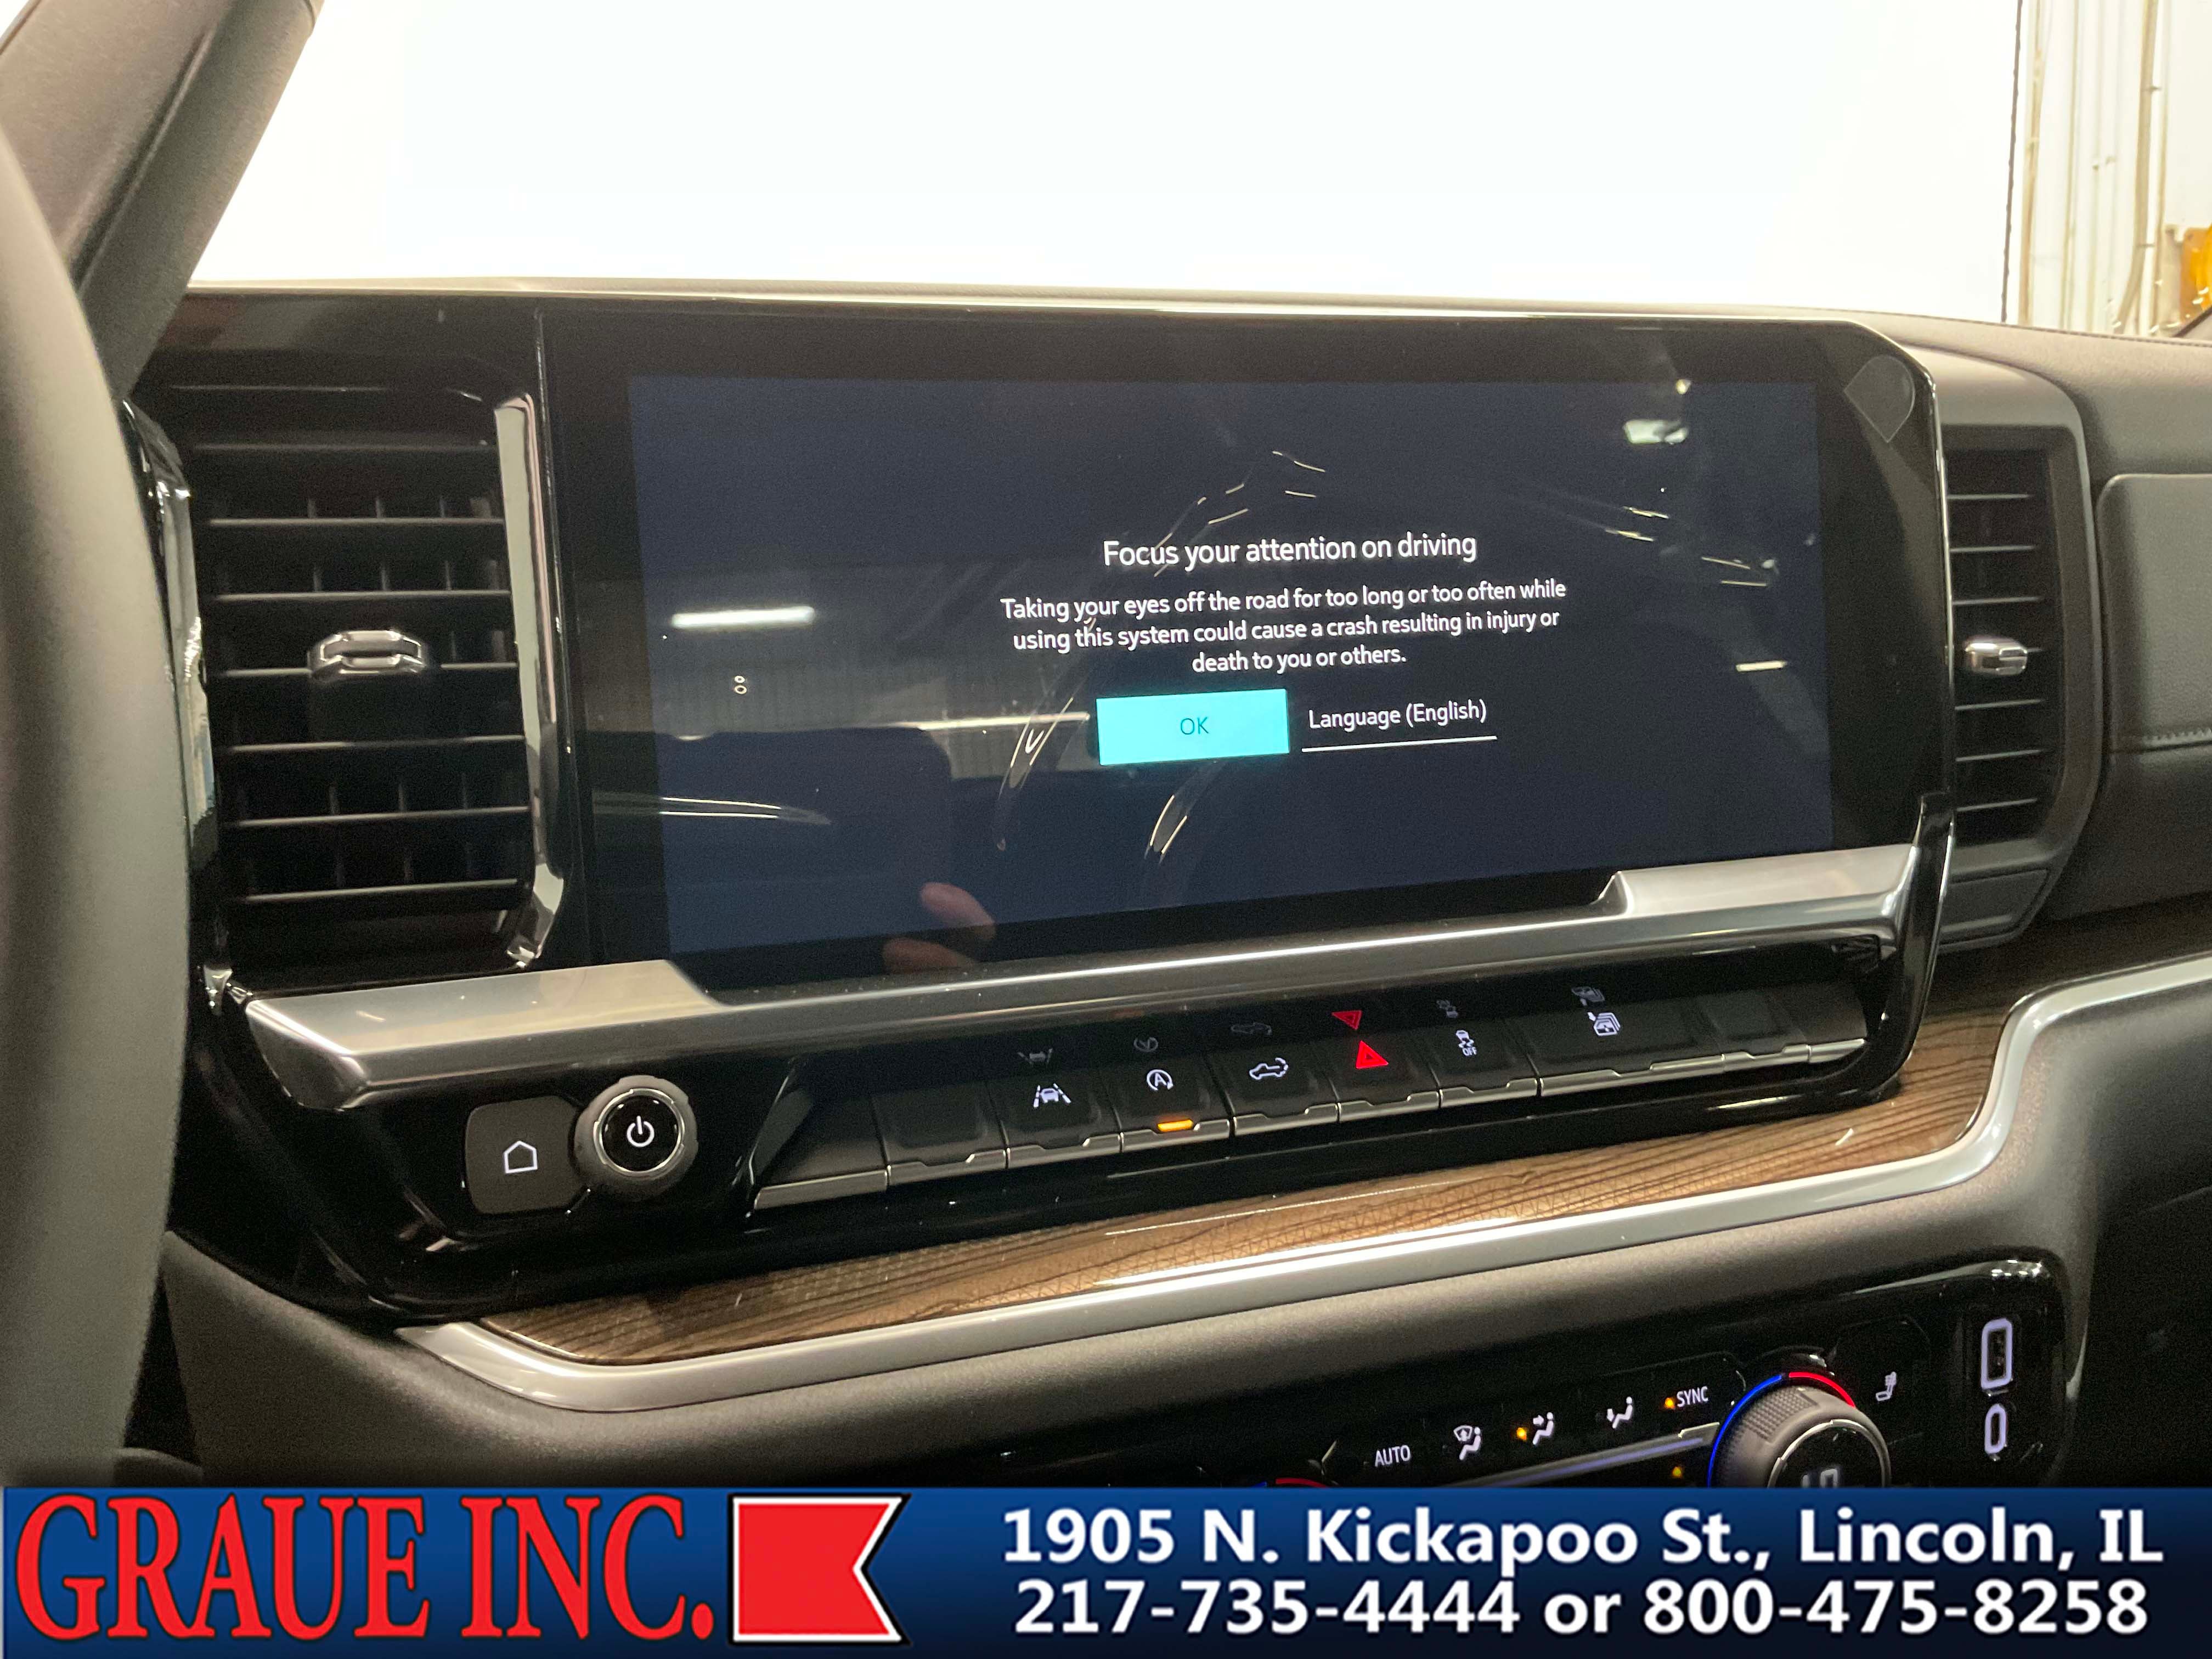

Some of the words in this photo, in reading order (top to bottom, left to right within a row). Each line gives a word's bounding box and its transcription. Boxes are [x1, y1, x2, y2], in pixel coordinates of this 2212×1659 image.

[1103, 539, 1179, 567] Focus
[1183, 544, 1241, 572] your
[1245, 535, 1357, 563] attention
[1361, 539, 1392, 560] on
[1397, 530, 1477, 563] driving
[1000, 596, 1070, 623] Taking
[1073, 601, 1120, 623] your
[1123, 599, 1171, 620] eyes
[1174, 590, 1206, 612] off
[1208, 590, 1242, 611] the
[1245, 588, 1290, 610] road
[1293, 589, 1321, 608] for
[1324, 588, 1359, 607] too
[1362, 585, 1404, 610] long
[1408, 589, 1428, 605] or
[1431, 585, 1464, 604] too
[1466, 580, 1516, 601] often
[1519, 578, 1567, 600] while
[1013, 629, 1071, 654] using
[1074, 627, 1114, 648] this
[1117, 625, 1189, 651] system
[1193, 619, 1248, 643] could
[1251, 623, 1308, 640] cause
[1310, 623, 1323, 637] a
[1326, 614, 1379, 637] crash
[1381, 612, 1463, 637] resulting
[1465, 612, 1483, 632] in
[1486, 610, 1537, 635] injury
[1539, 611, 1560, 628] or
[1191, 650, 1248, 674] death
[1251, 651, 1272, 670] to
[1276, 653, 1313, 675] you
[1316, 651, 1336, 667] or
[1339, 644, 1407, 667] others.
[1180, 716, 1209, 735] OK
[1308, 709, 1402, 733] Language
[1406, 699, 1487, 729] (English)
[1462, 1047, 1477, 1056] OFF
[1675, 1385, 1709, 1409] SYNC
[1374, 1444, 1412, 1468] AUTO
